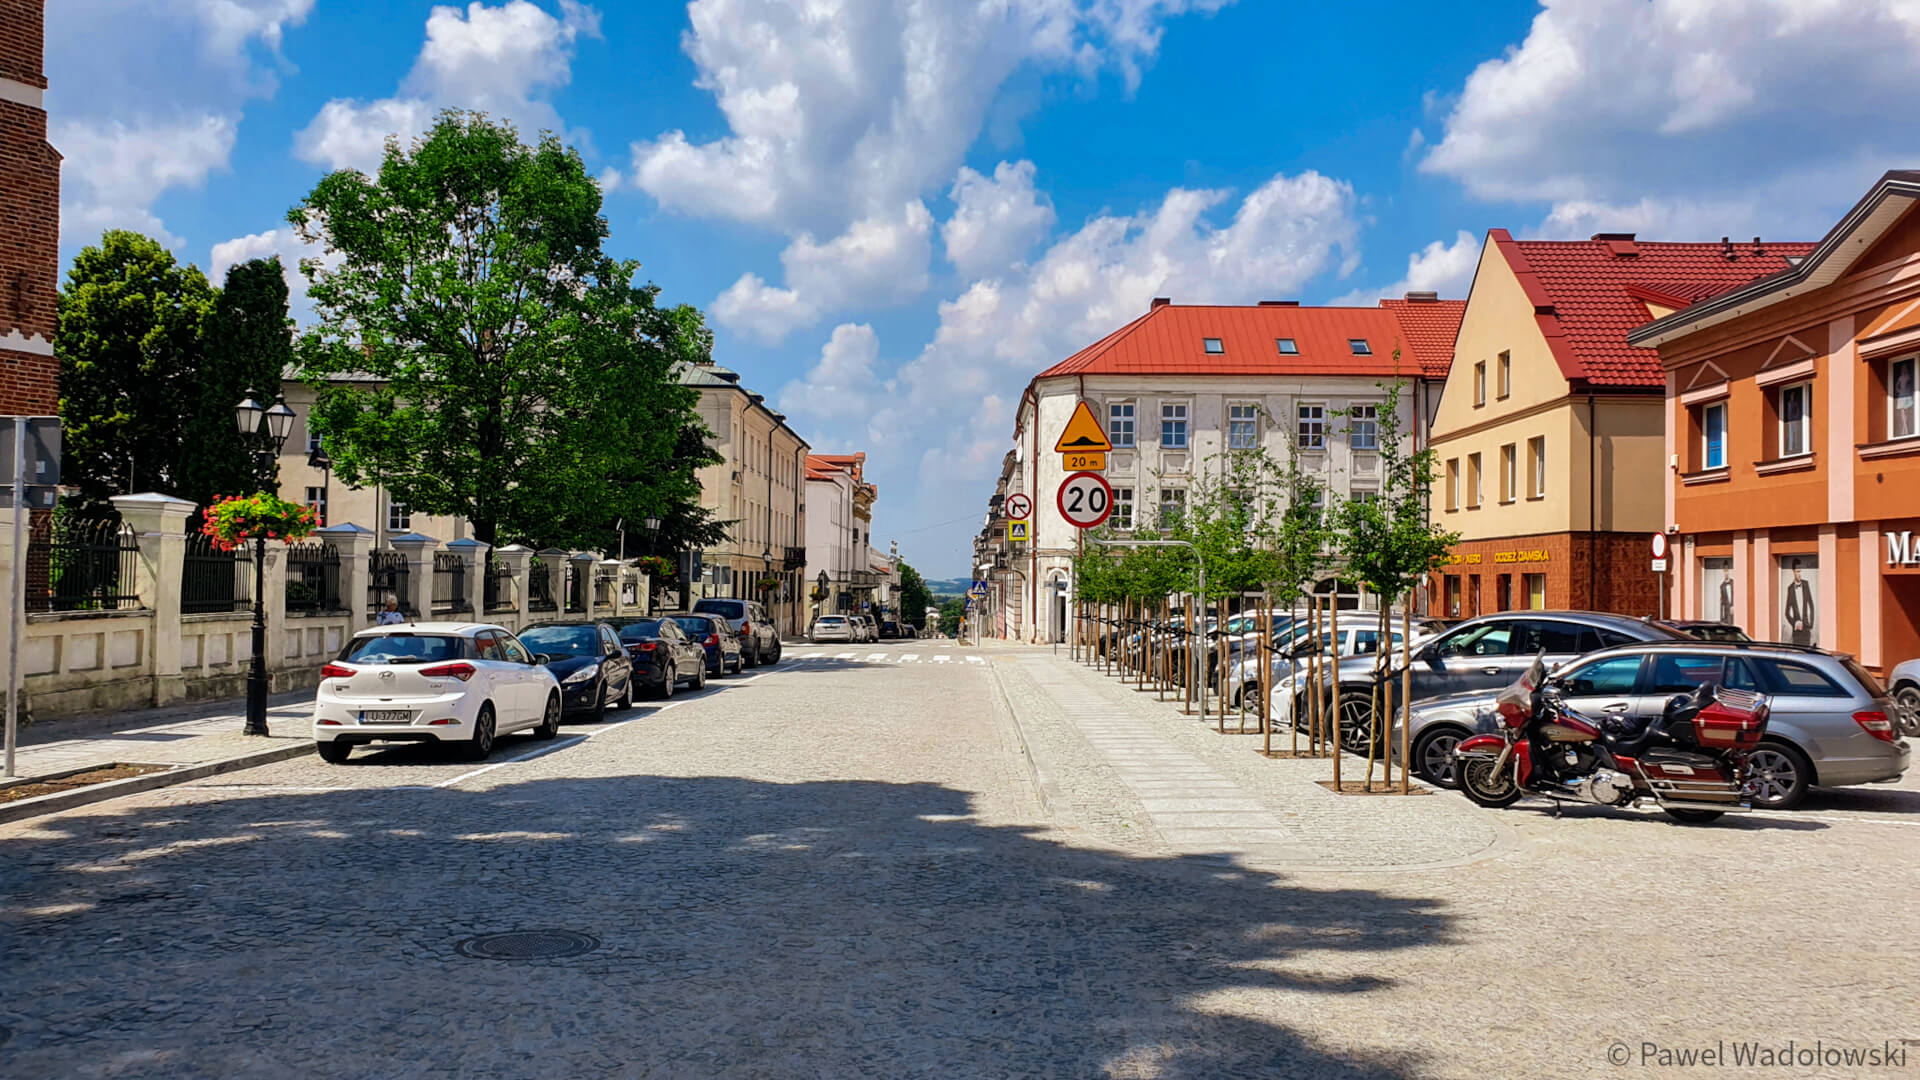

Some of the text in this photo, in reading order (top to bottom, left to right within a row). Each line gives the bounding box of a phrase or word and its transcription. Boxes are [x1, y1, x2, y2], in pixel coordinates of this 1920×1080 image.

[1072, 457, 1086, 467] 20
[1068, 486, 1106, 513] 20
[1518, 550, 1549, 562] DAMSKA
